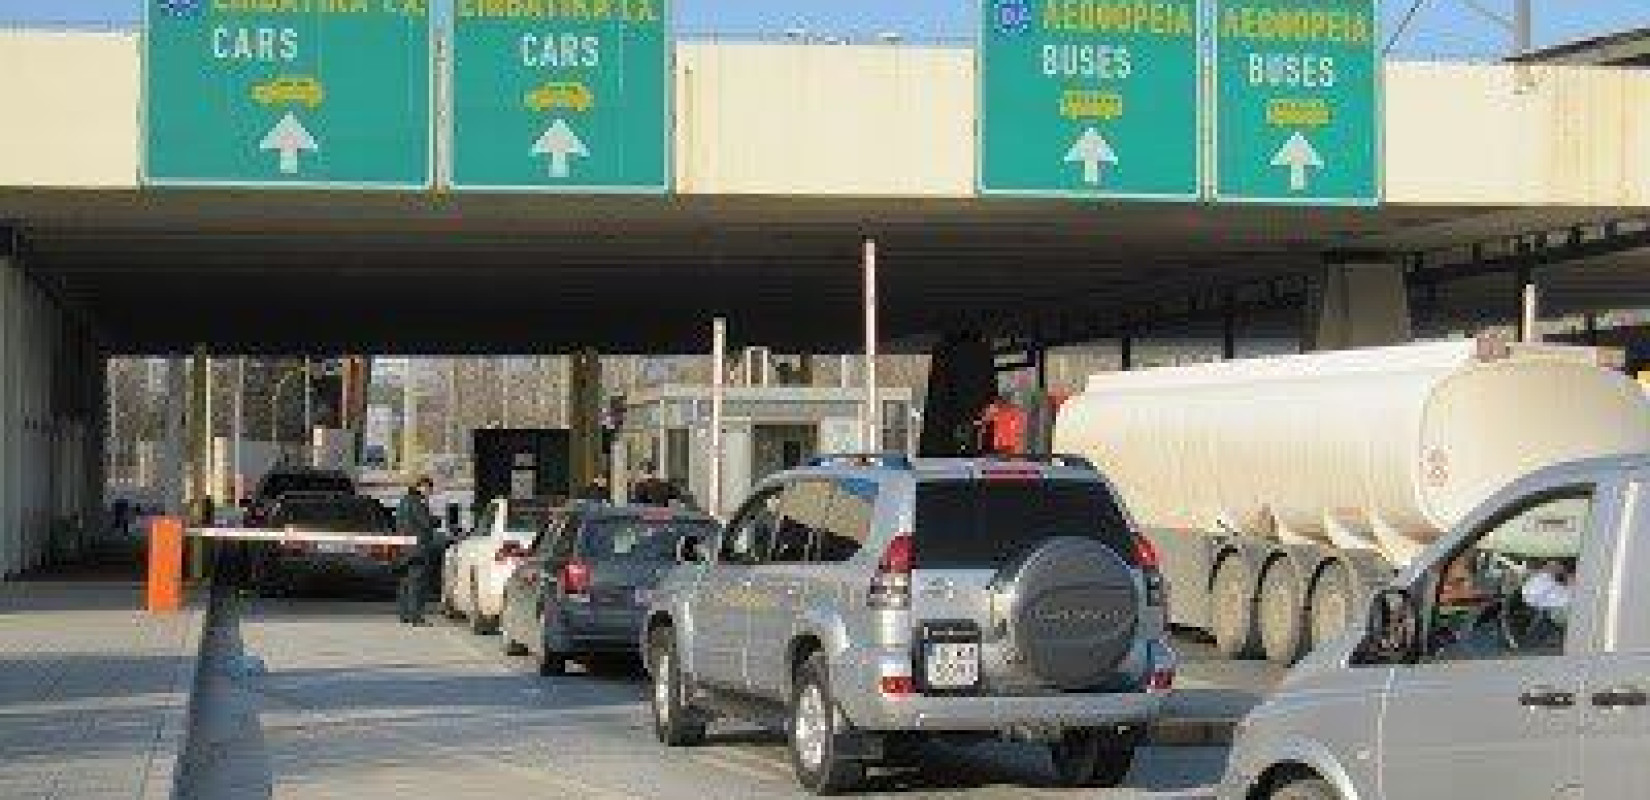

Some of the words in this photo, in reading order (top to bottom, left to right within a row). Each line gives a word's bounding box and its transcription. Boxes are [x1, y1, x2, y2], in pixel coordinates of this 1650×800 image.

[213, 27, 298, 58] CARS
[523, 33, 599, 67] CARS
[1043, 45, 1131, 78] BUSES
[1250, 53, 1333, 87] BUSES
